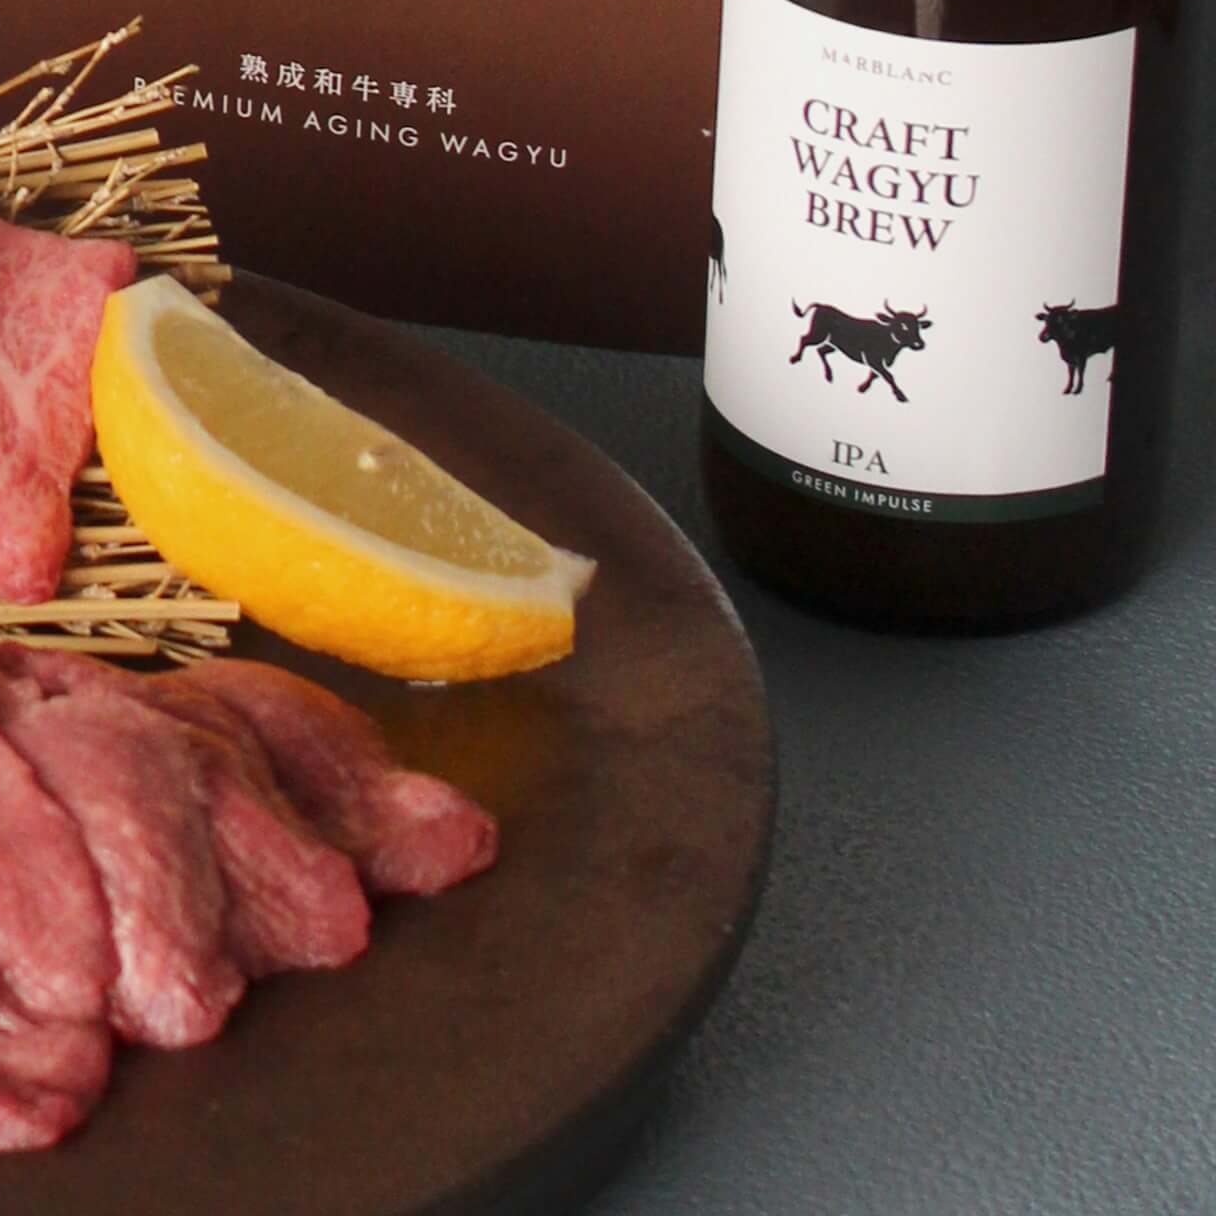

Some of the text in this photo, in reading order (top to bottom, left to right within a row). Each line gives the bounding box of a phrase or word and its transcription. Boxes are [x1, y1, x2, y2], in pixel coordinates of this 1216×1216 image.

[239, 53, 457, 115] 熟成和牛専科
[821, 47, 953, 86] MARBLANC
[134, 76, 567, 168] PEMIUM AGING WAGYU
[802, 97, 971, 161] CRAFT
[789, 135, 981, 209] WAGYU
[805, 189, 955, 252] BREW
[831, 439, 890, 475] IPA
[791, 469, 934, 514] GREEN IMPULSE
